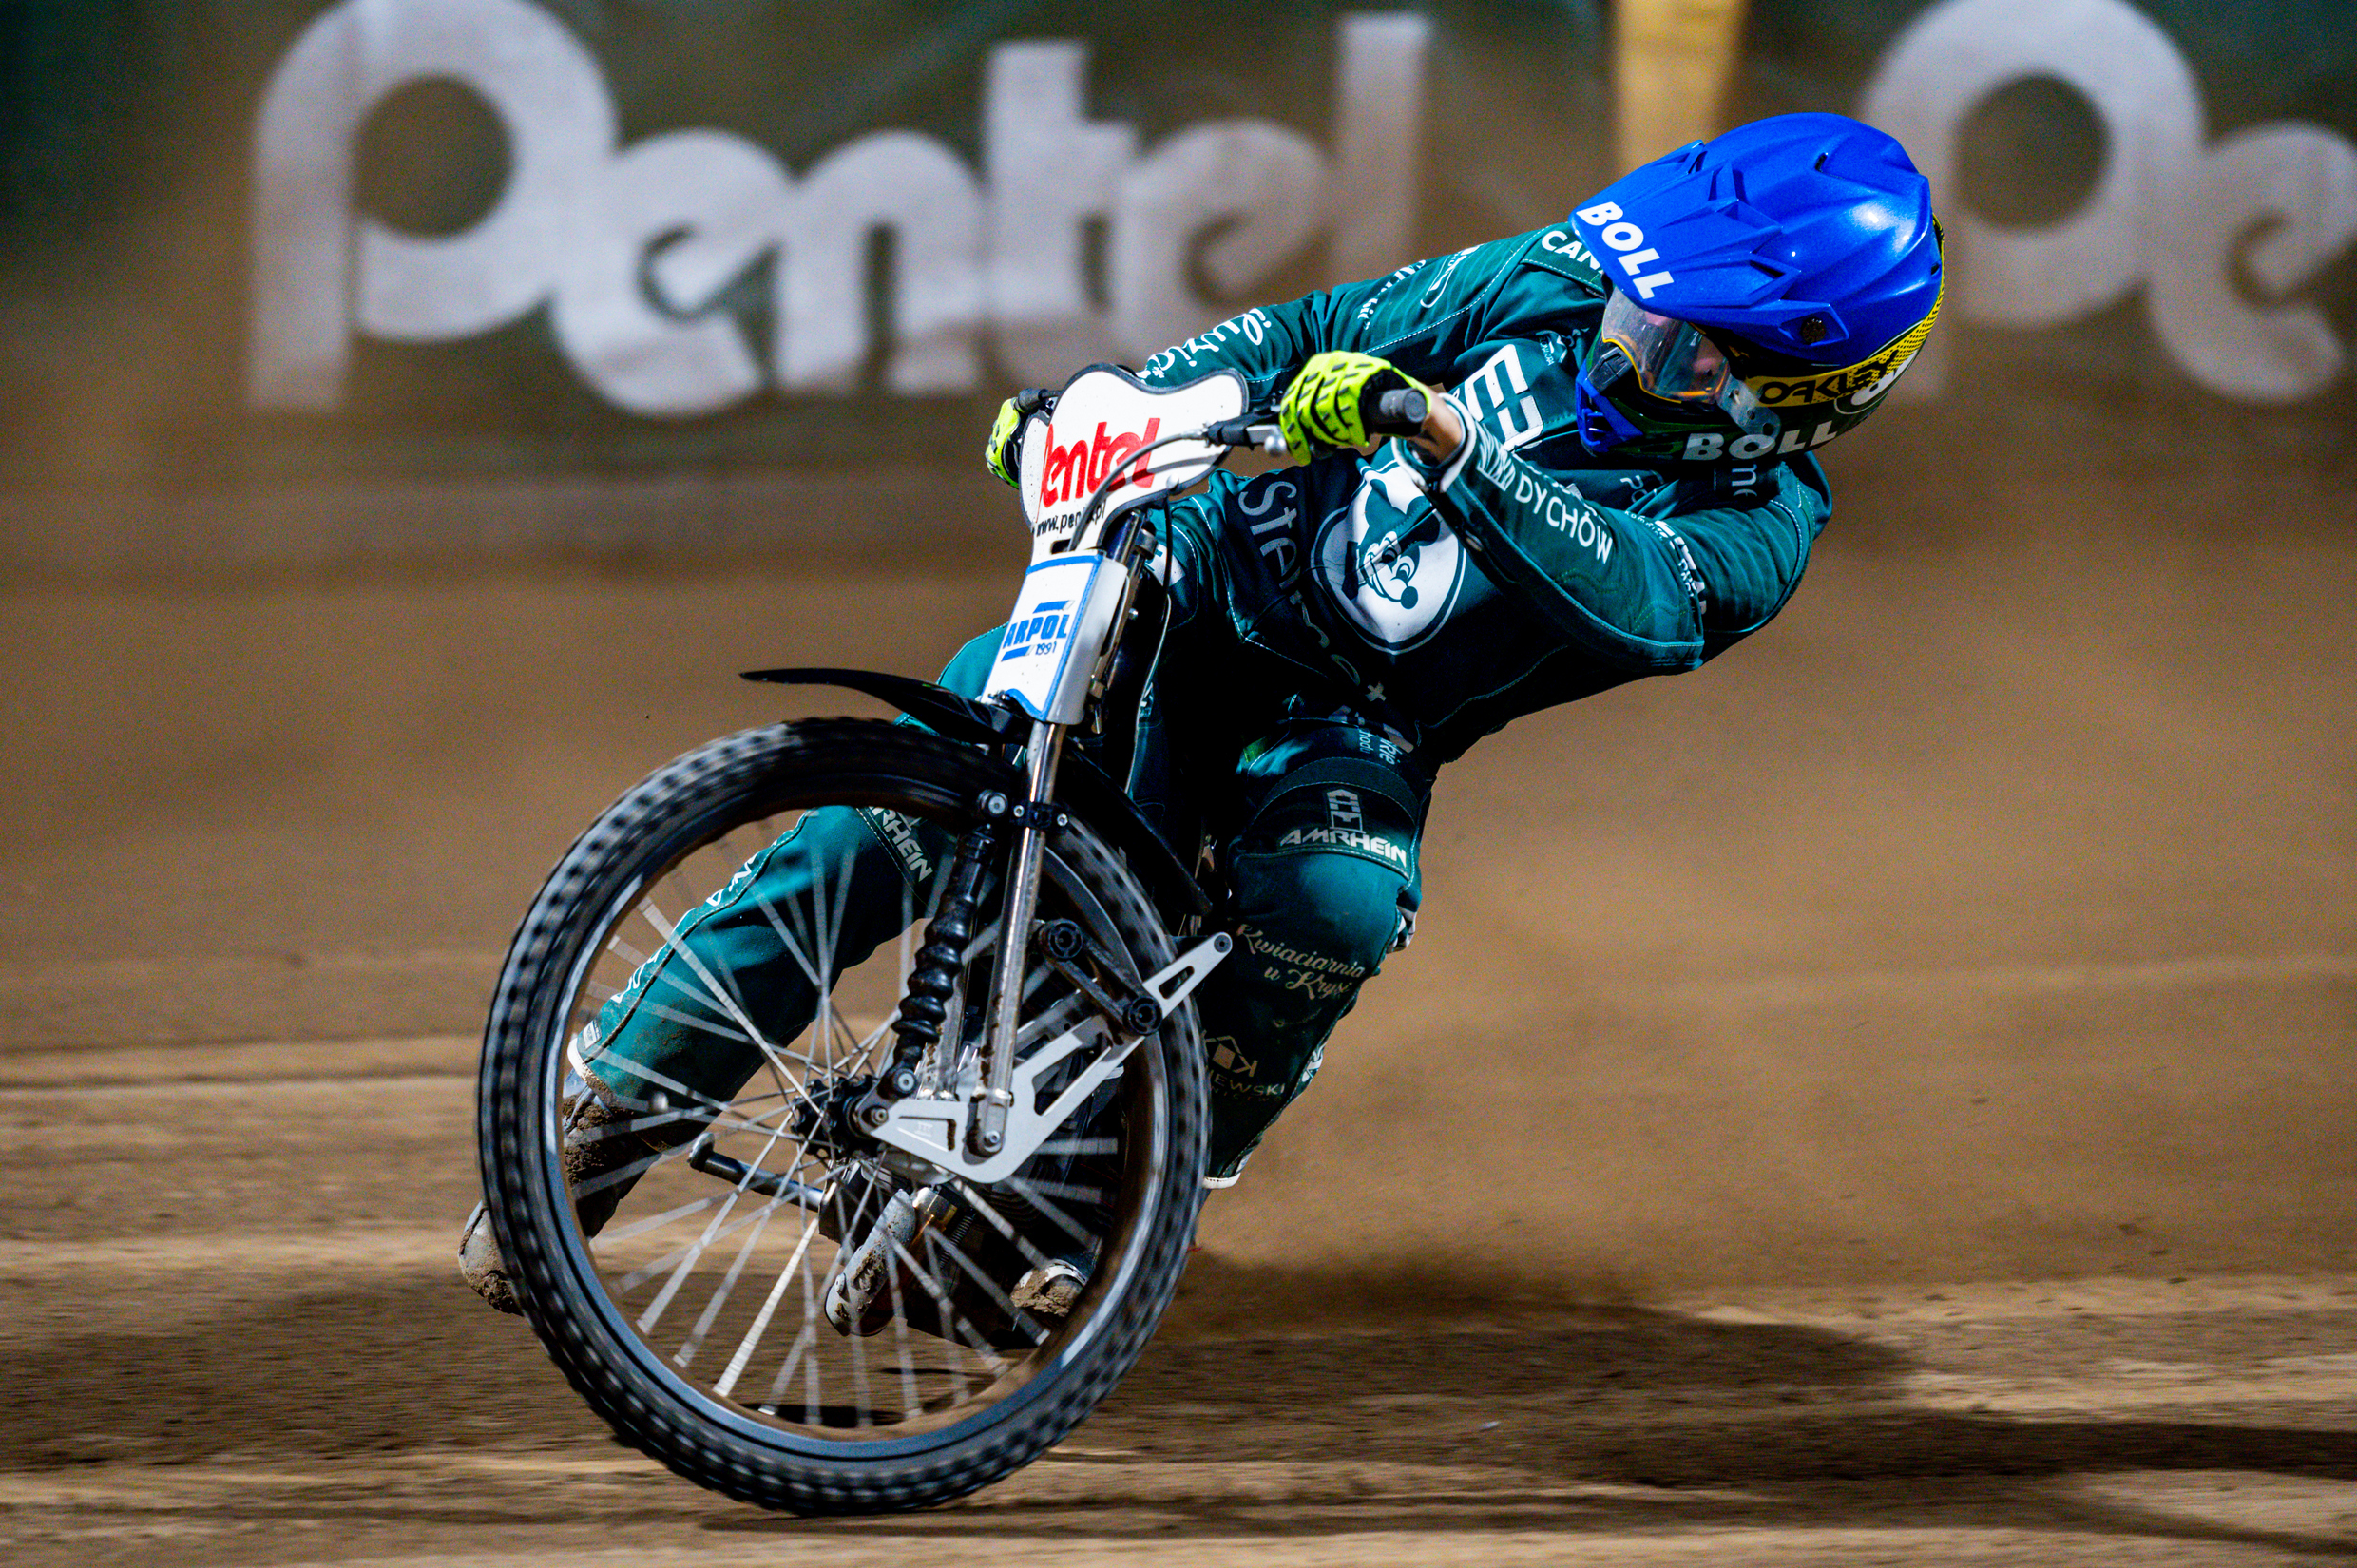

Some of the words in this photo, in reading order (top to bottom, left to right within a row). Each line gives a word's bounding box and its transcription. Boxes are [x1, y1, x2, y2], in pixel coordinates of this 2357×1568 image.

[249, 0, 1432, 416] Pentel
[1575, 201, 1675, 299] BOLL
[1759, 349, 1899, 404] OAKLEY
[1043, 417, 1161, 508] entel
[1682, 420, 1837, 461] BOLL
[1002, 614, 1070, 649] ARPOL
[1035, 641, 1058, 656] 1991
[1279, 828, 1407, 870] AMRHEIN
[1236, 923, 1367, 980] Kwiaciarnia
